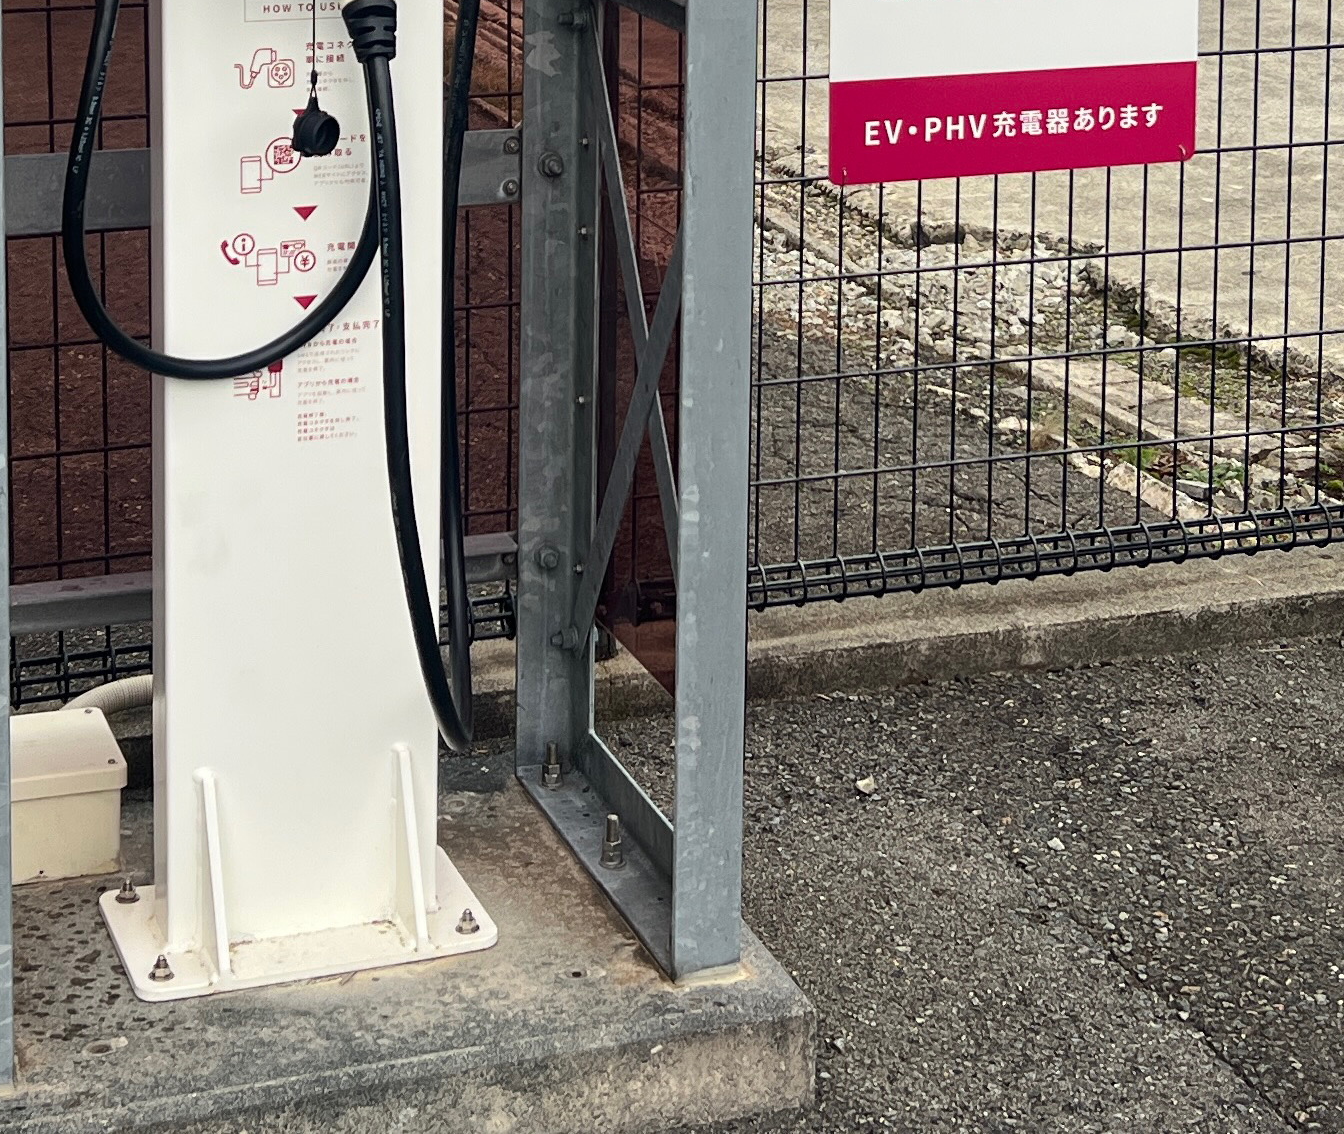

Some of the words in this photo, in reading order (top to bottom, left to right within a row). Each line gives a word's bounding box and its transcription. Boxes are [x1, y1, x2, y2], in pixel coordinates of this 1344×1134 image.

[263, 4, 292, 13] HOW
[298, 3, 315, 12] TO
[305, 40, 354, 51] 充電コネク
[327, 241, 356, 252] 充電開
[326, 319, 380, 332] 了・支払完了
